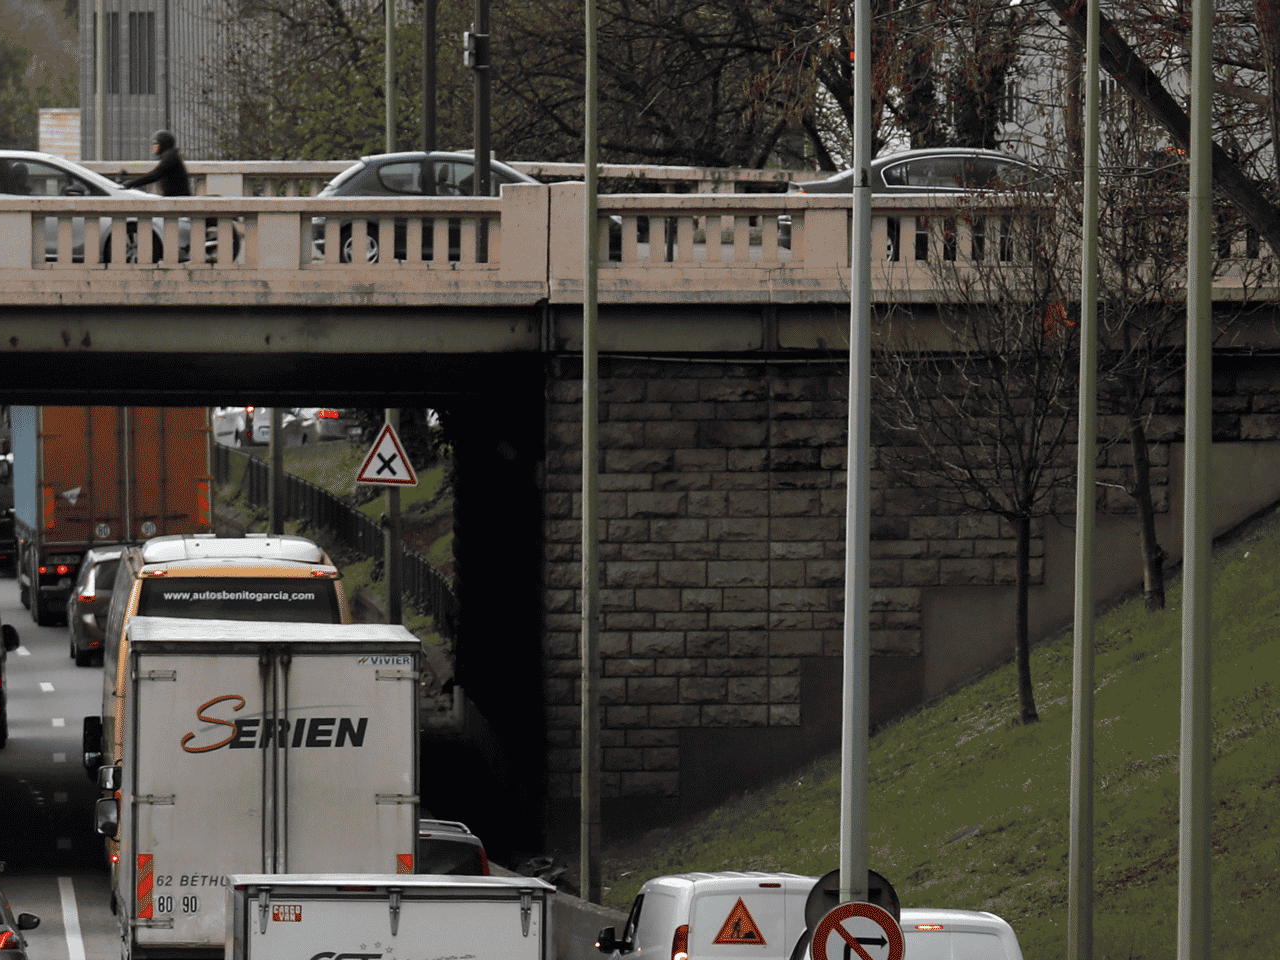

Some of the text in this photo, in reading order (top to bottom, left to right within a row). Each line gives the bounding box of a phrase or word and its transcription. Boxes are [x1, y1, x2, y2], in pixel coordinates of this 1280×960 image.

[163, 590, 315, 602] www.autosbenitogarcia.com
[181, 694, 369, 753] SERIEN
[156, 875, 172, 887] 62
[157, 896, 198, 912] 80 90
